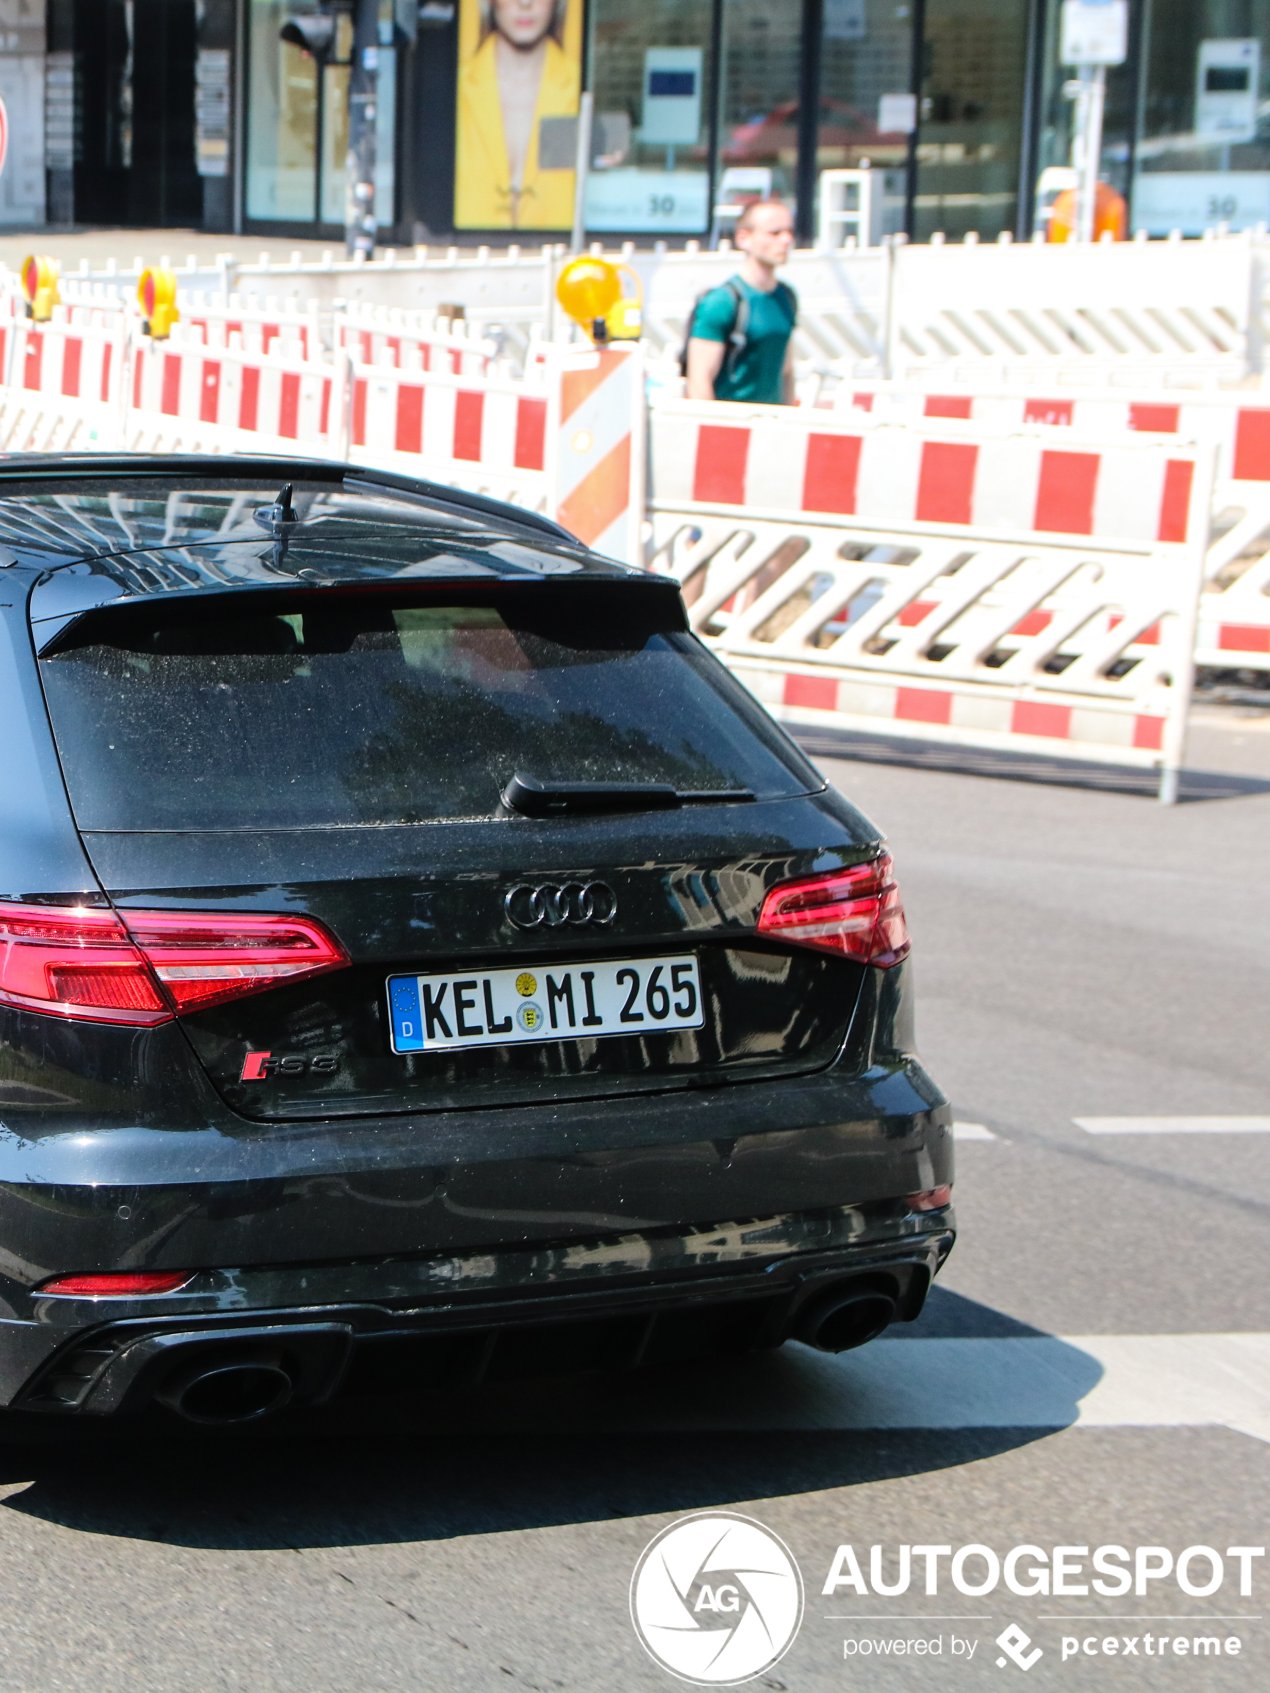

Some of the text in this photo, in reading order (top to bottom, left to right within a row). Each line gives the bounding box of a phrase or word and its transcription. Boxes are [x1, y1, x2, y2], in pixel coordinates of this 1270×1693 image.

[422, 963, 698, 1040] KEL MI 265
[401, 1021, 414, 1038] D
